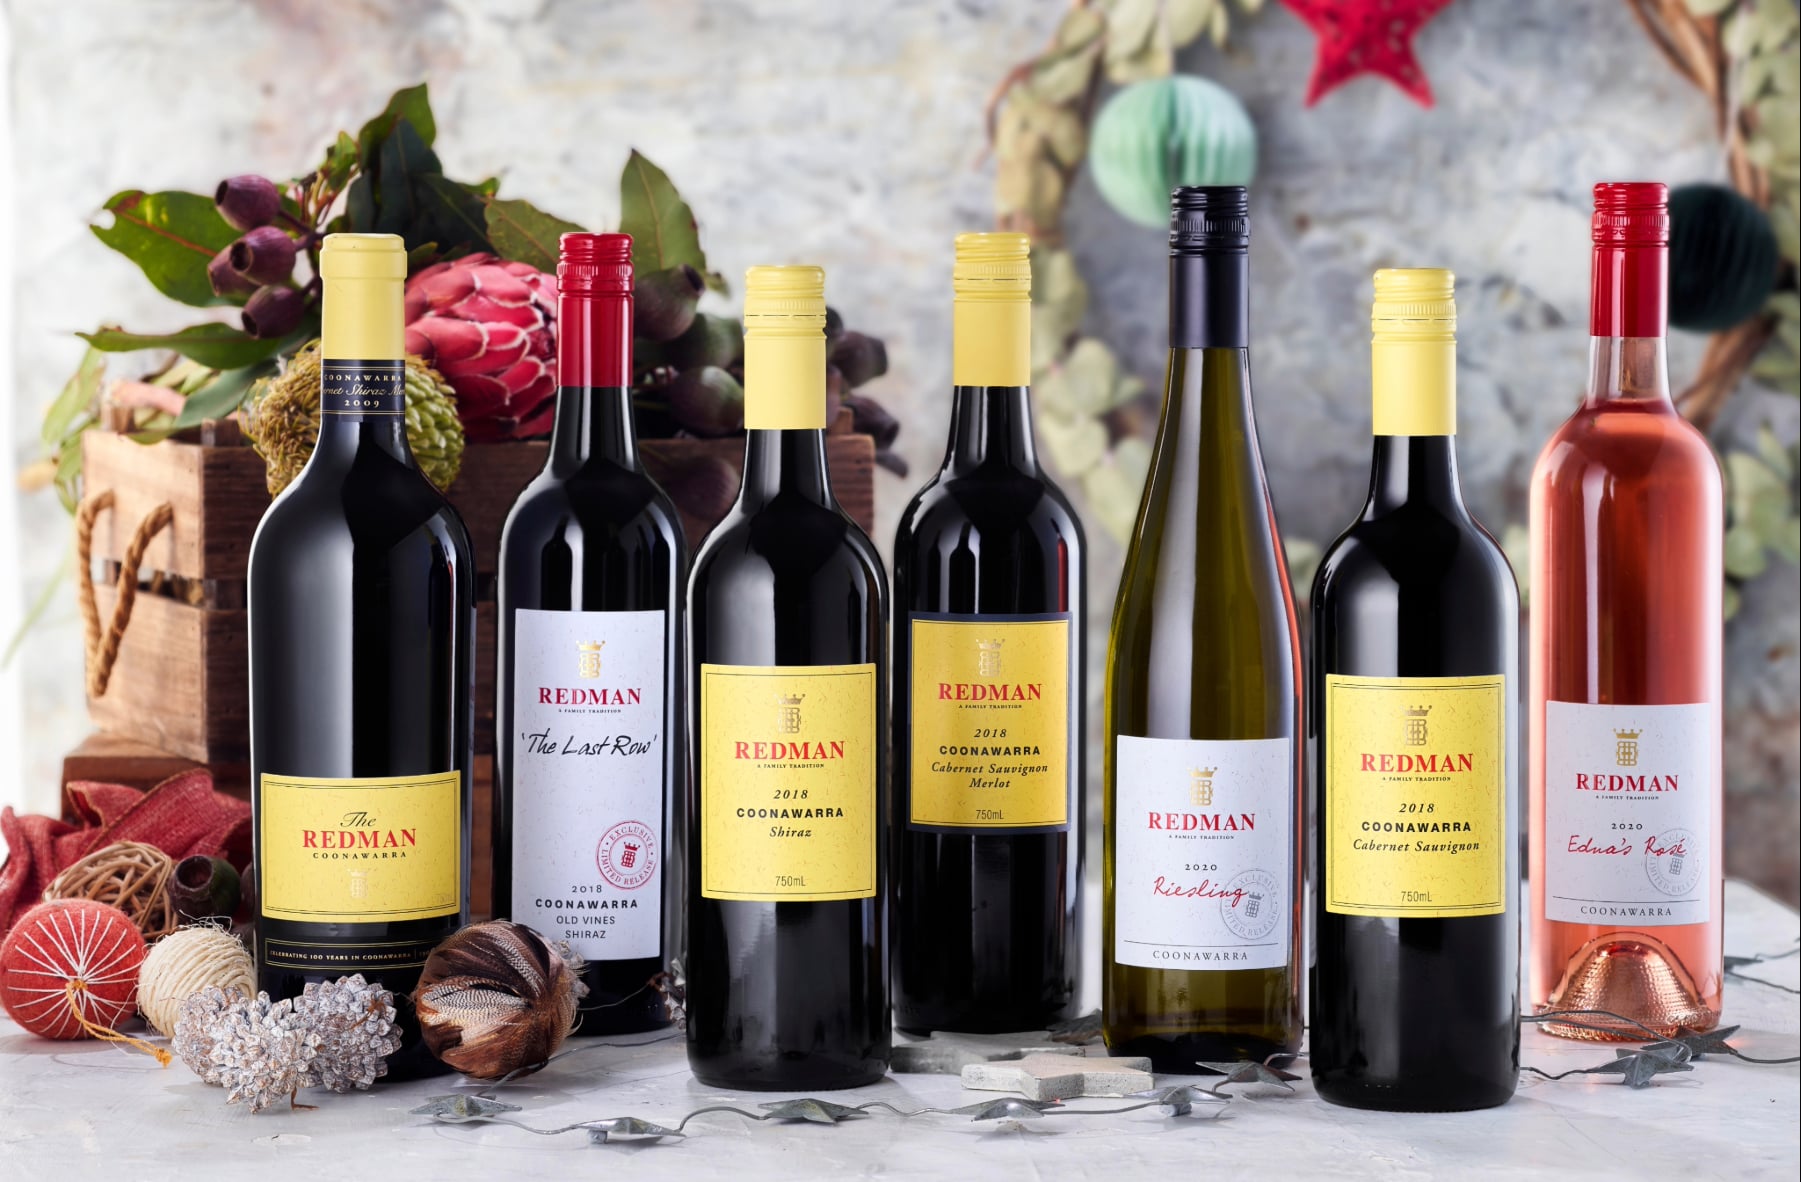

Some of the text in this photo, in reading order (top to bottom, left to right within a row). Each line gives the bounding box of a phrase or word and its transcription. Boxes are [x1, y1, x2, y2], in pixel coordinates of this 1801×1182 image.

[345, 384, 387, 396] Shiraz
[344, 400, 380, 408] 2009
[538, 686, 642, 705] REDMAN
[938, 683, 1042, 701] REDMAN
[974, 728, 1008, 738] 2018
[562, 735, 610, 756] Last
[734, 740, 845, 760] REDMAN
[939, 745, 1041, 756] COONAWARRA
[1360, 753, 1473, 772] REDMAN
[931, 762, 1048, 777] Cabernet Sauvignon
[969, 778, 1011, 788] Merlot
[1576, 772, 1679, 792] REDMAN
[773, 789, 809, 800] 2018
[736, 808, 844, 819] COONAWARRA
[976, 809, 1004, 820] 750mL
[1399, 803, 1435, 814] 2018
[340, 812, 376, 828] The
[1148, 811, 1256, 831] REDMAN
[1611, 822, 1643, 830] 2020
[769, 826, 812, 838] Shiraz
[1361, 821, 1472, 833] COONAWARRA
[302, 828, 416, 849] REDMAN
[608, 826, 654, 848] EXCLUSIVE
[1353, 838, 1480, 855] Cabernet Sauvignon
[1568, 834, 1687, 856] Edna's Rosé
[312, 851, 407, 860] COONAWARRA
[601, 849, 654, 886] LIMITED RELEASE
[775, 876, 806, 888] 750mL
[572, 884, 602, 893] 2018
[1153, 876, 1248, 908] Riesling
[1401, 890, 1432, 902] 750mL
[535, 898, 638, 910] COONAWARRA
[1580, 906, 1672, 916] COONAWARRA
[556, 916, 616, 925] OLD VINES
[565, 930, 606, 939] SHIRAZ
[270, 950, 308, 960] CELEBRATING
[362, 953, 411, 961] COONAWARRA
[1152, 950, 1248, 961] COONAWARRA
